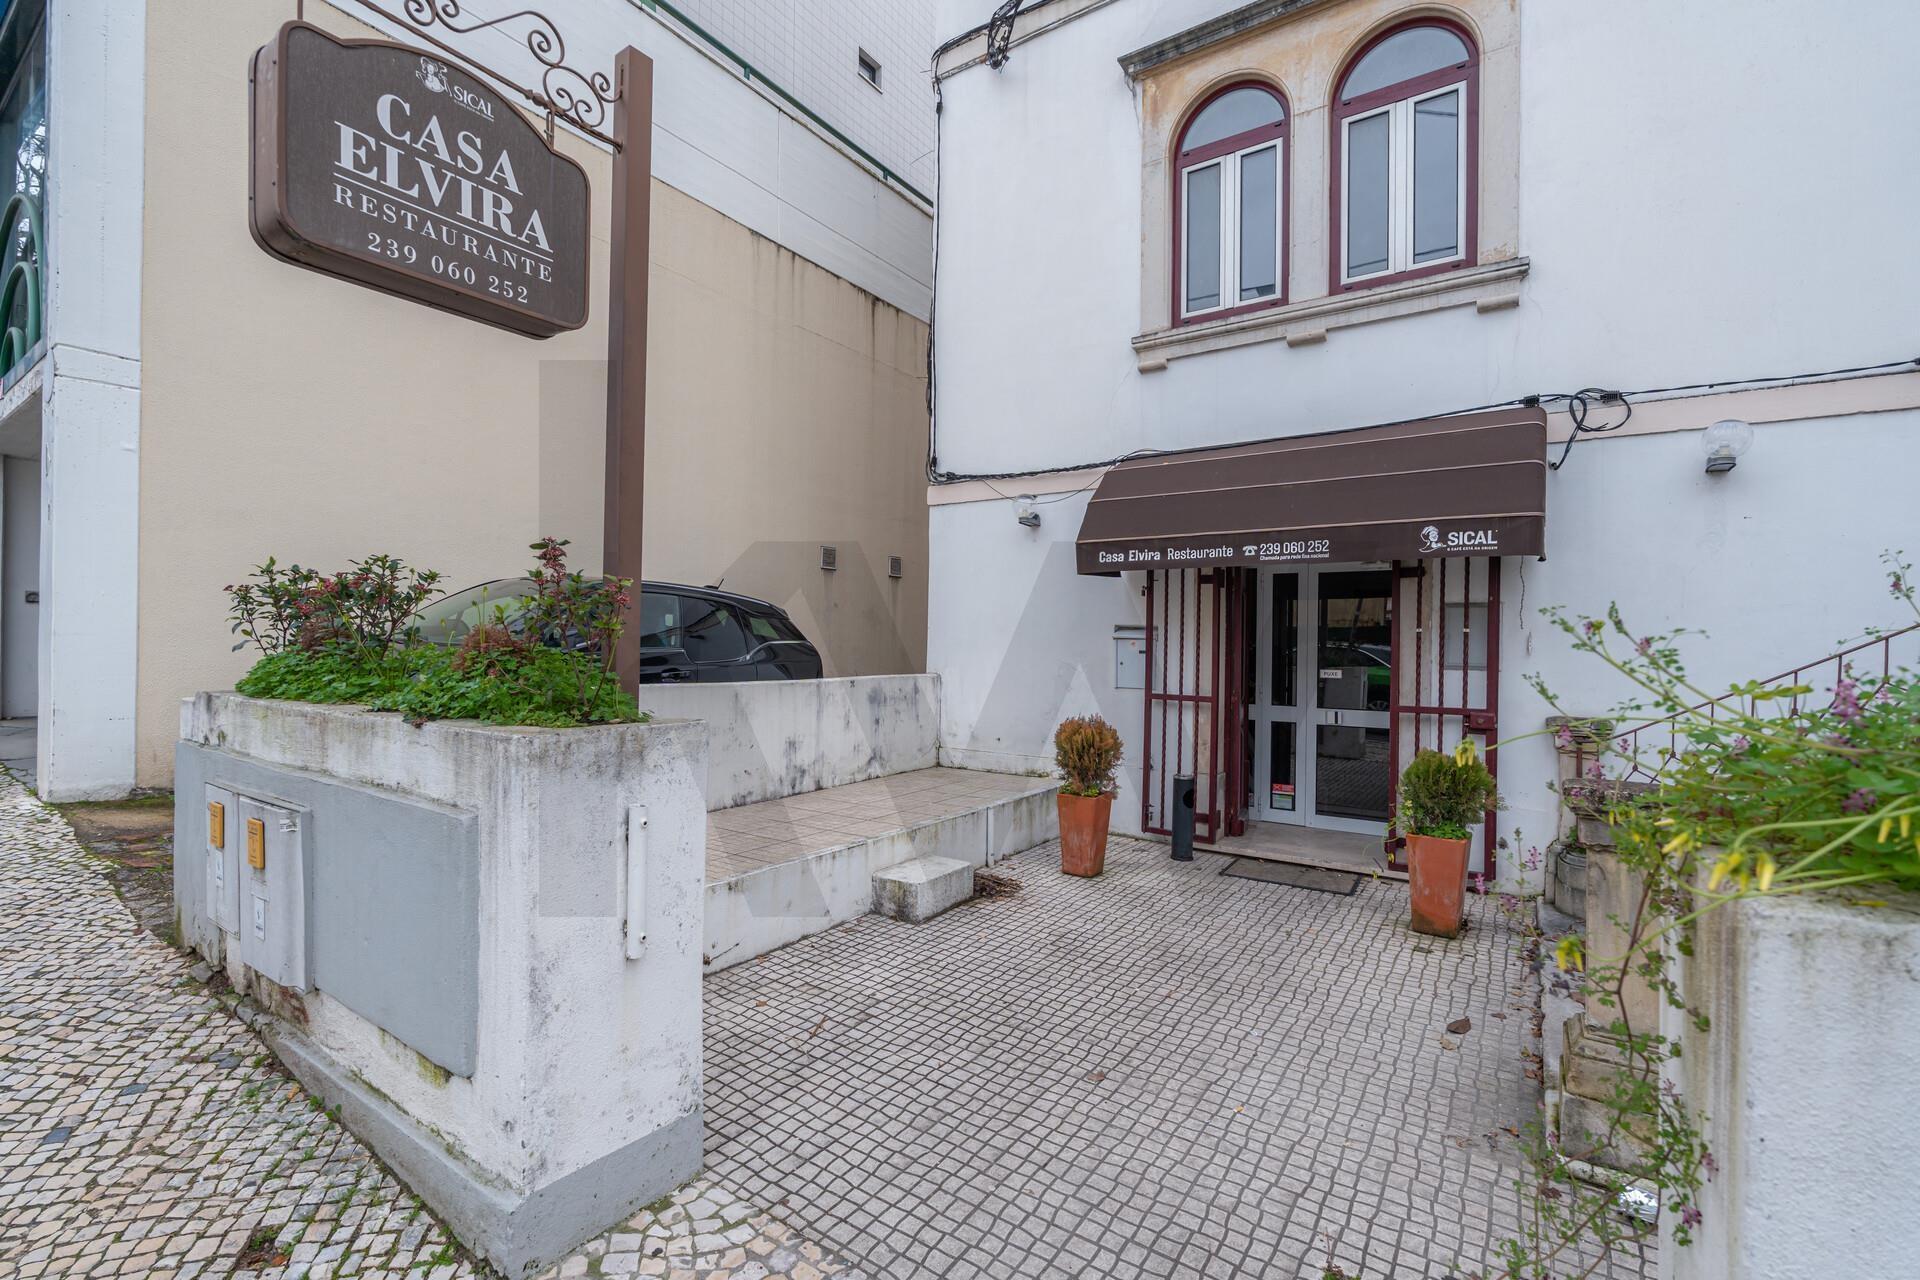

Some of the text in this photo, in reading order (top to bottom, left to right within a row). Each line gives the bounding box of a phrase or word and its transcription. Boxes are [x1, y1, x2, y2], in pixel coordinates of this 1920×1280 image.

[453, 85, 495, 119] SICAL
[376, 93, 524, 196] CASA
[333, 120, 554, 254] ELVIRA
[333, 182, 553, 282] RESTAURANTE
[367, 232, 528, 303] 239 060 252
[1098, 545, 1233, 563] Casa Elvira Restaurante
[1260, 539, 1330, 555] 239 060 252
[1447, 530, 1498, 546] SICAL
